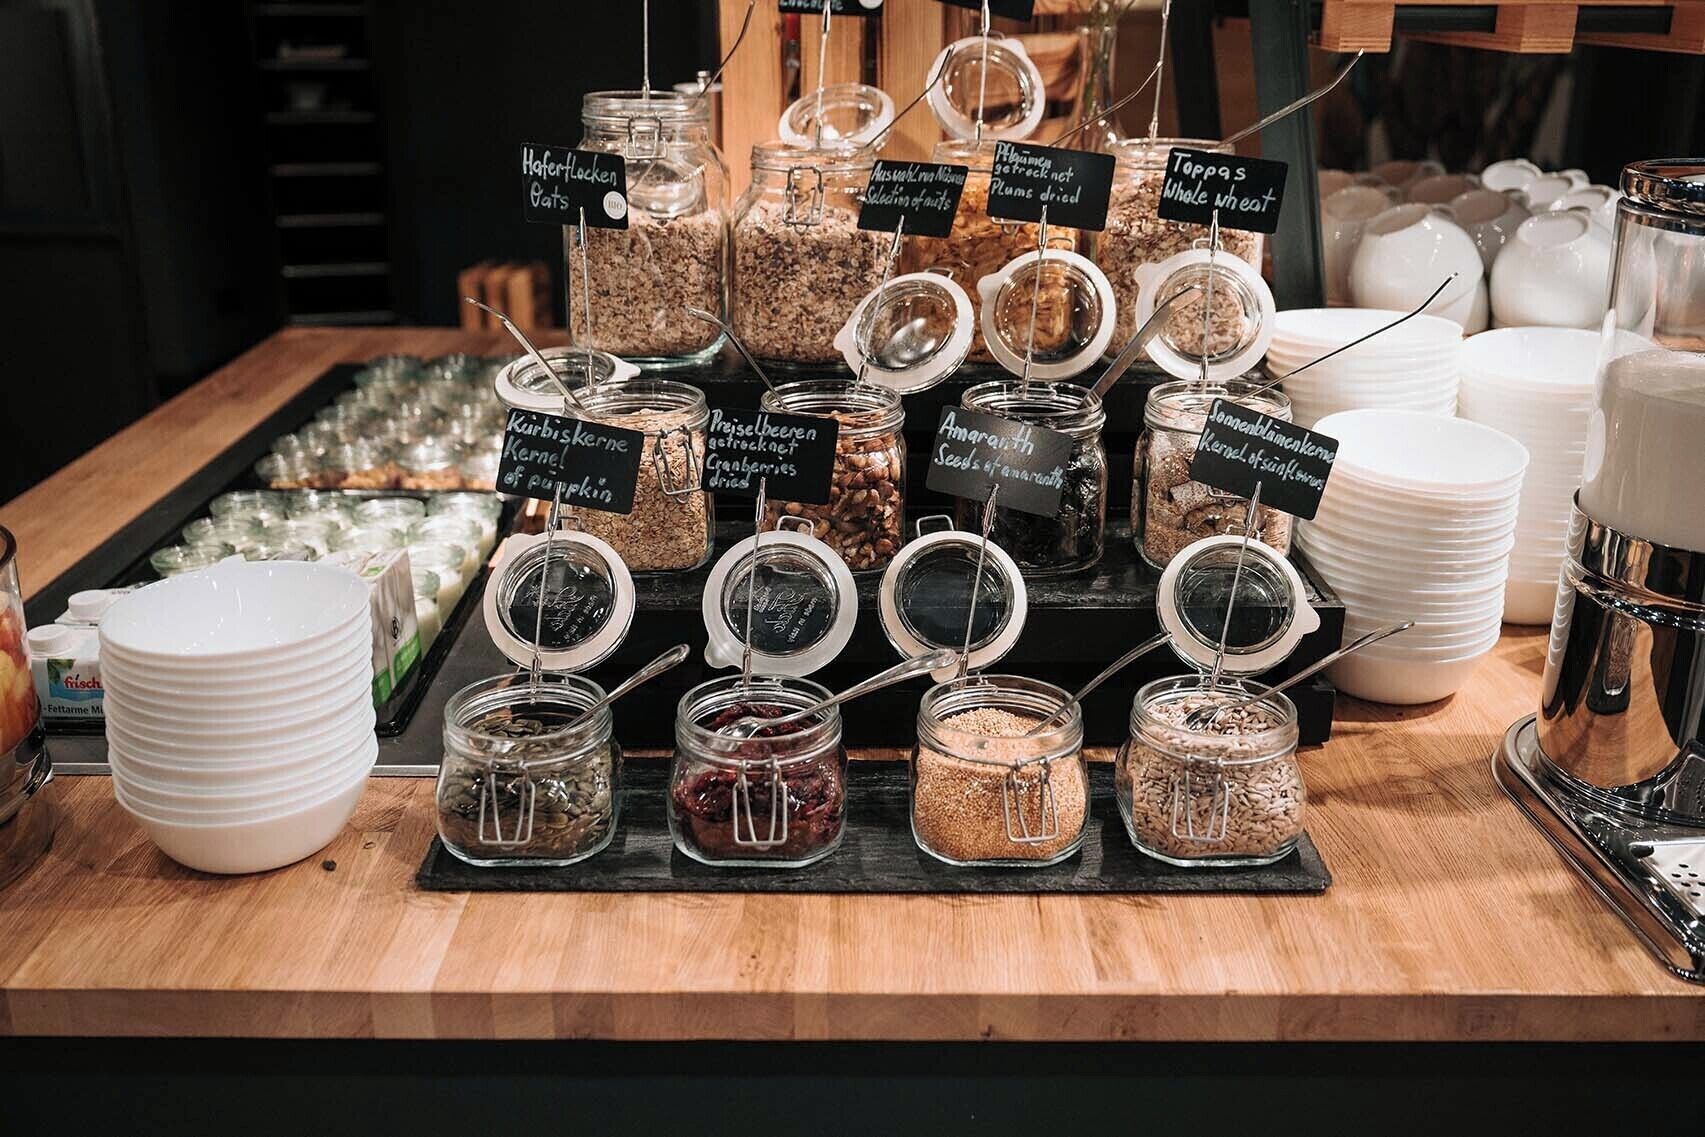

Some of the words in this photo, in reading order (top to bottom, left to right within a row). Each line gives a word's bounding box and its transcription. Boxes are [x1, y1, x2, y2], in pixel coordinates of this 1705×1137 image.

[522, 146, 617, 186] Haferflocken
[1173, 151, 1247, 181] Toppas
[530, 181, 569, 210] Oats
[911, 188, 927, 212] of
[990, 177, 1034, 200] Plums
[1039, 185, 1082, 204] dried
[1162, 177, 1209, 206] Whole
[1214, 183, 1277, 213] wheat
[710, 409, 818, 441] Preiselbeeren
[939, 410, 1035, 456] Amaranth
[502, 434, 569, 470] Kernel
[708, 432, 799, 456] getrocknet
[1199, 428, 1249, 463] Kernel
[1247, 448, 1266, 470] of
[503, 464, 525, 489] of
[705, 453, 797, 477] Cranberries
[708, 468, 750, 488] dried
[934, 442, 981, 471] Seeds
[983, 455, 1002, 478] of
[1000, 465, 1064, 490] amaranth
